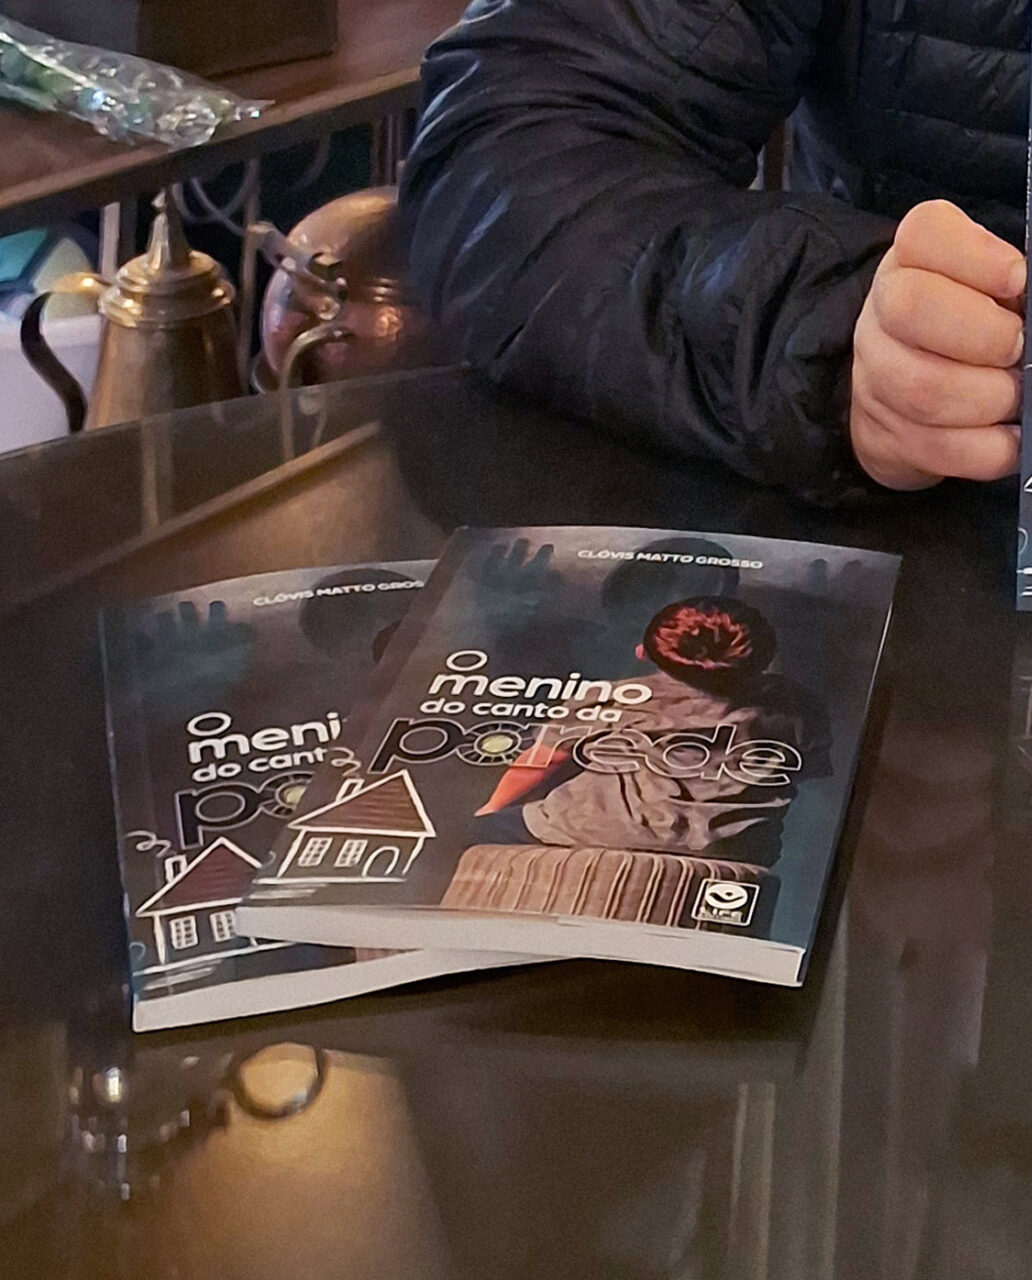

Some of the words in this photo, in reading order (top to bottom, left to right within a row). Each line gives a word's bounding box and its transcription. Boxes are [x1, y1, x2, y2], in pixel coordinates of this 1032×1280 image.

[577, 548, 635, 561] CLÓVIS
[636, 552, 695, 564] MATTO
[695, 557, 764, 570] GROSSO
[315, 584, 376, 597] MATTO
[446, 649, 488, 672] O
[428, 672, 653, 706] menino
[420, 698, 466, 715] do
[472, 701, 570, 719] canto
[576, 704, 623, 723] da
[187, 711, 232, 737] O
[188, 712, 342, 764] meni
[192, 762, 242, 782] do
[248, 747, 328, 772] cant
[367, 718, 802, 787] parede
